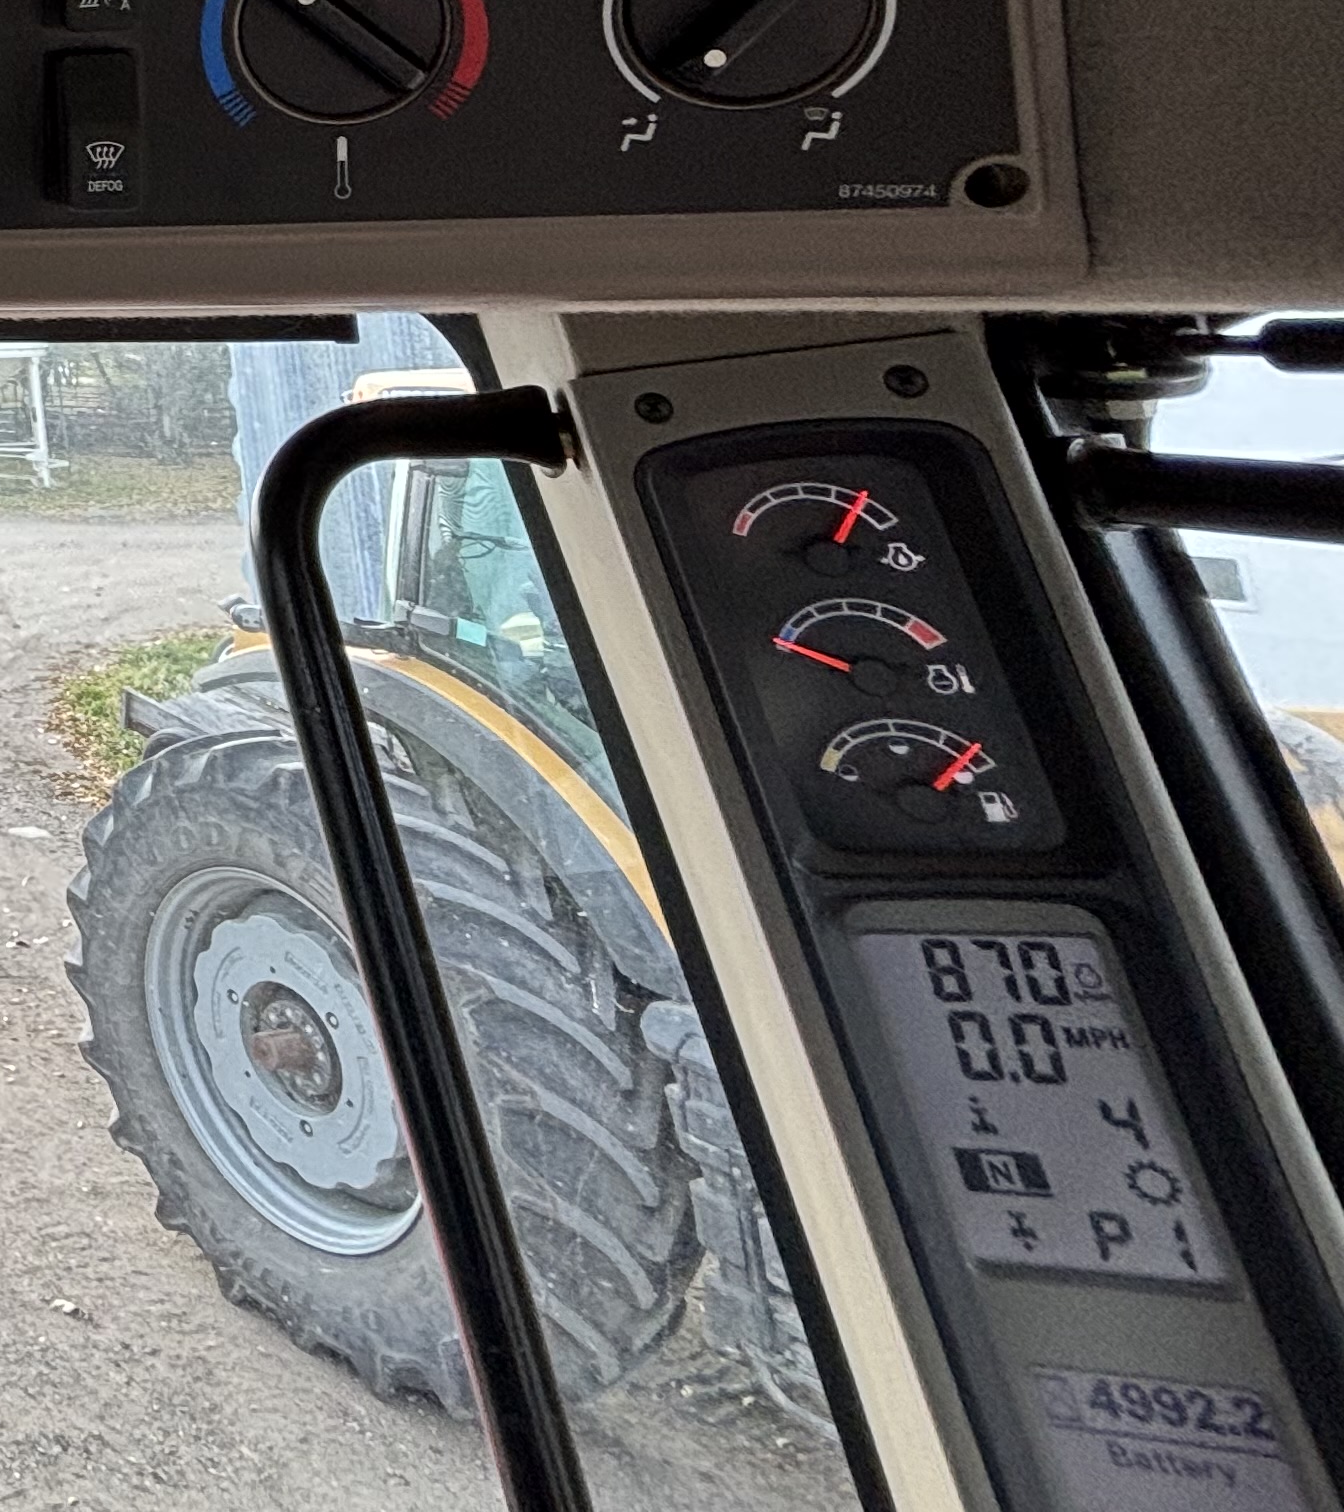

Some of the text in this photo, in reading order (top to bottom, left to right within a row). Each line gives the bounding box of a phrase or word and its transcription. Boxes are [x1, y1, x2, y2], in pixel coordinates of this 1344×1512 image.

[87, 180, 124, 192] DEFOG
[921, 939, 1071, 1005] 870
[947, 1010, 1130, 1086] 0.0 MPH
[1097, 1097, 1149, 1150] 4
[985, 1159, 1015, 1186] N
[1089, 1378, 1275, 1439] 4992.2
[1104, 1439, 1238, 1489] Battery
